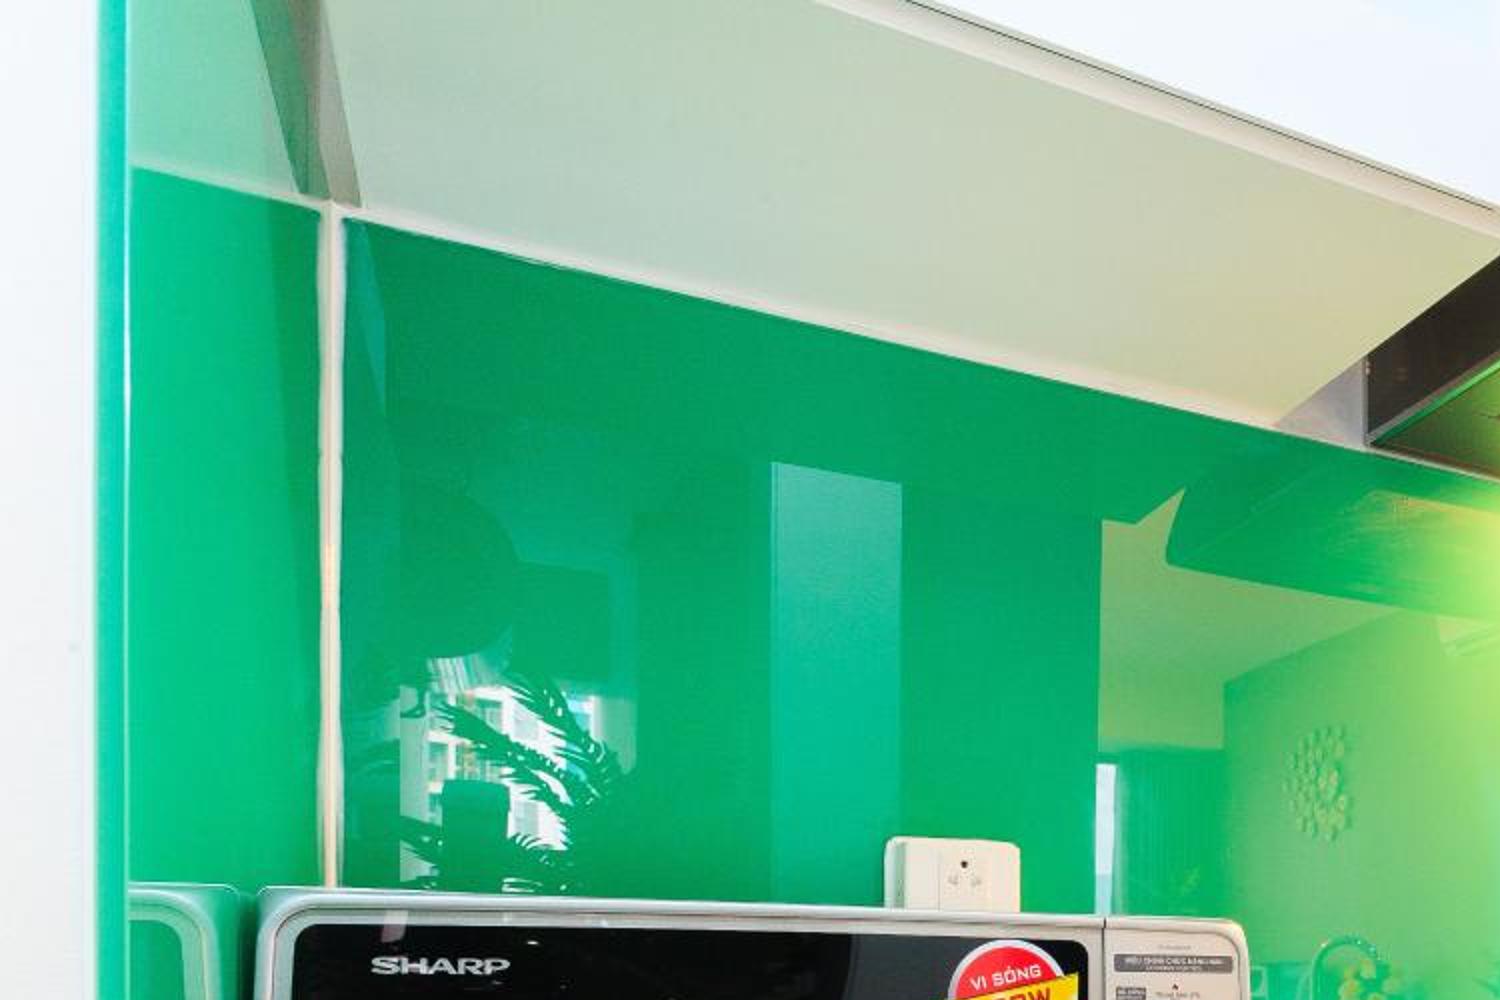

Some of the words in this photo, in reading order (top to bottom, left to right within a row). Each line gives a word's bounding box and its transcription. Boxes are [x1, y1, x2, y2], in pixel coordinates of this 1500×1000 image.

[371, 956, 511, 976] SHARP
[970, 975, 987, 990] VI
[992, 964, 1042, 987] SÓNG
